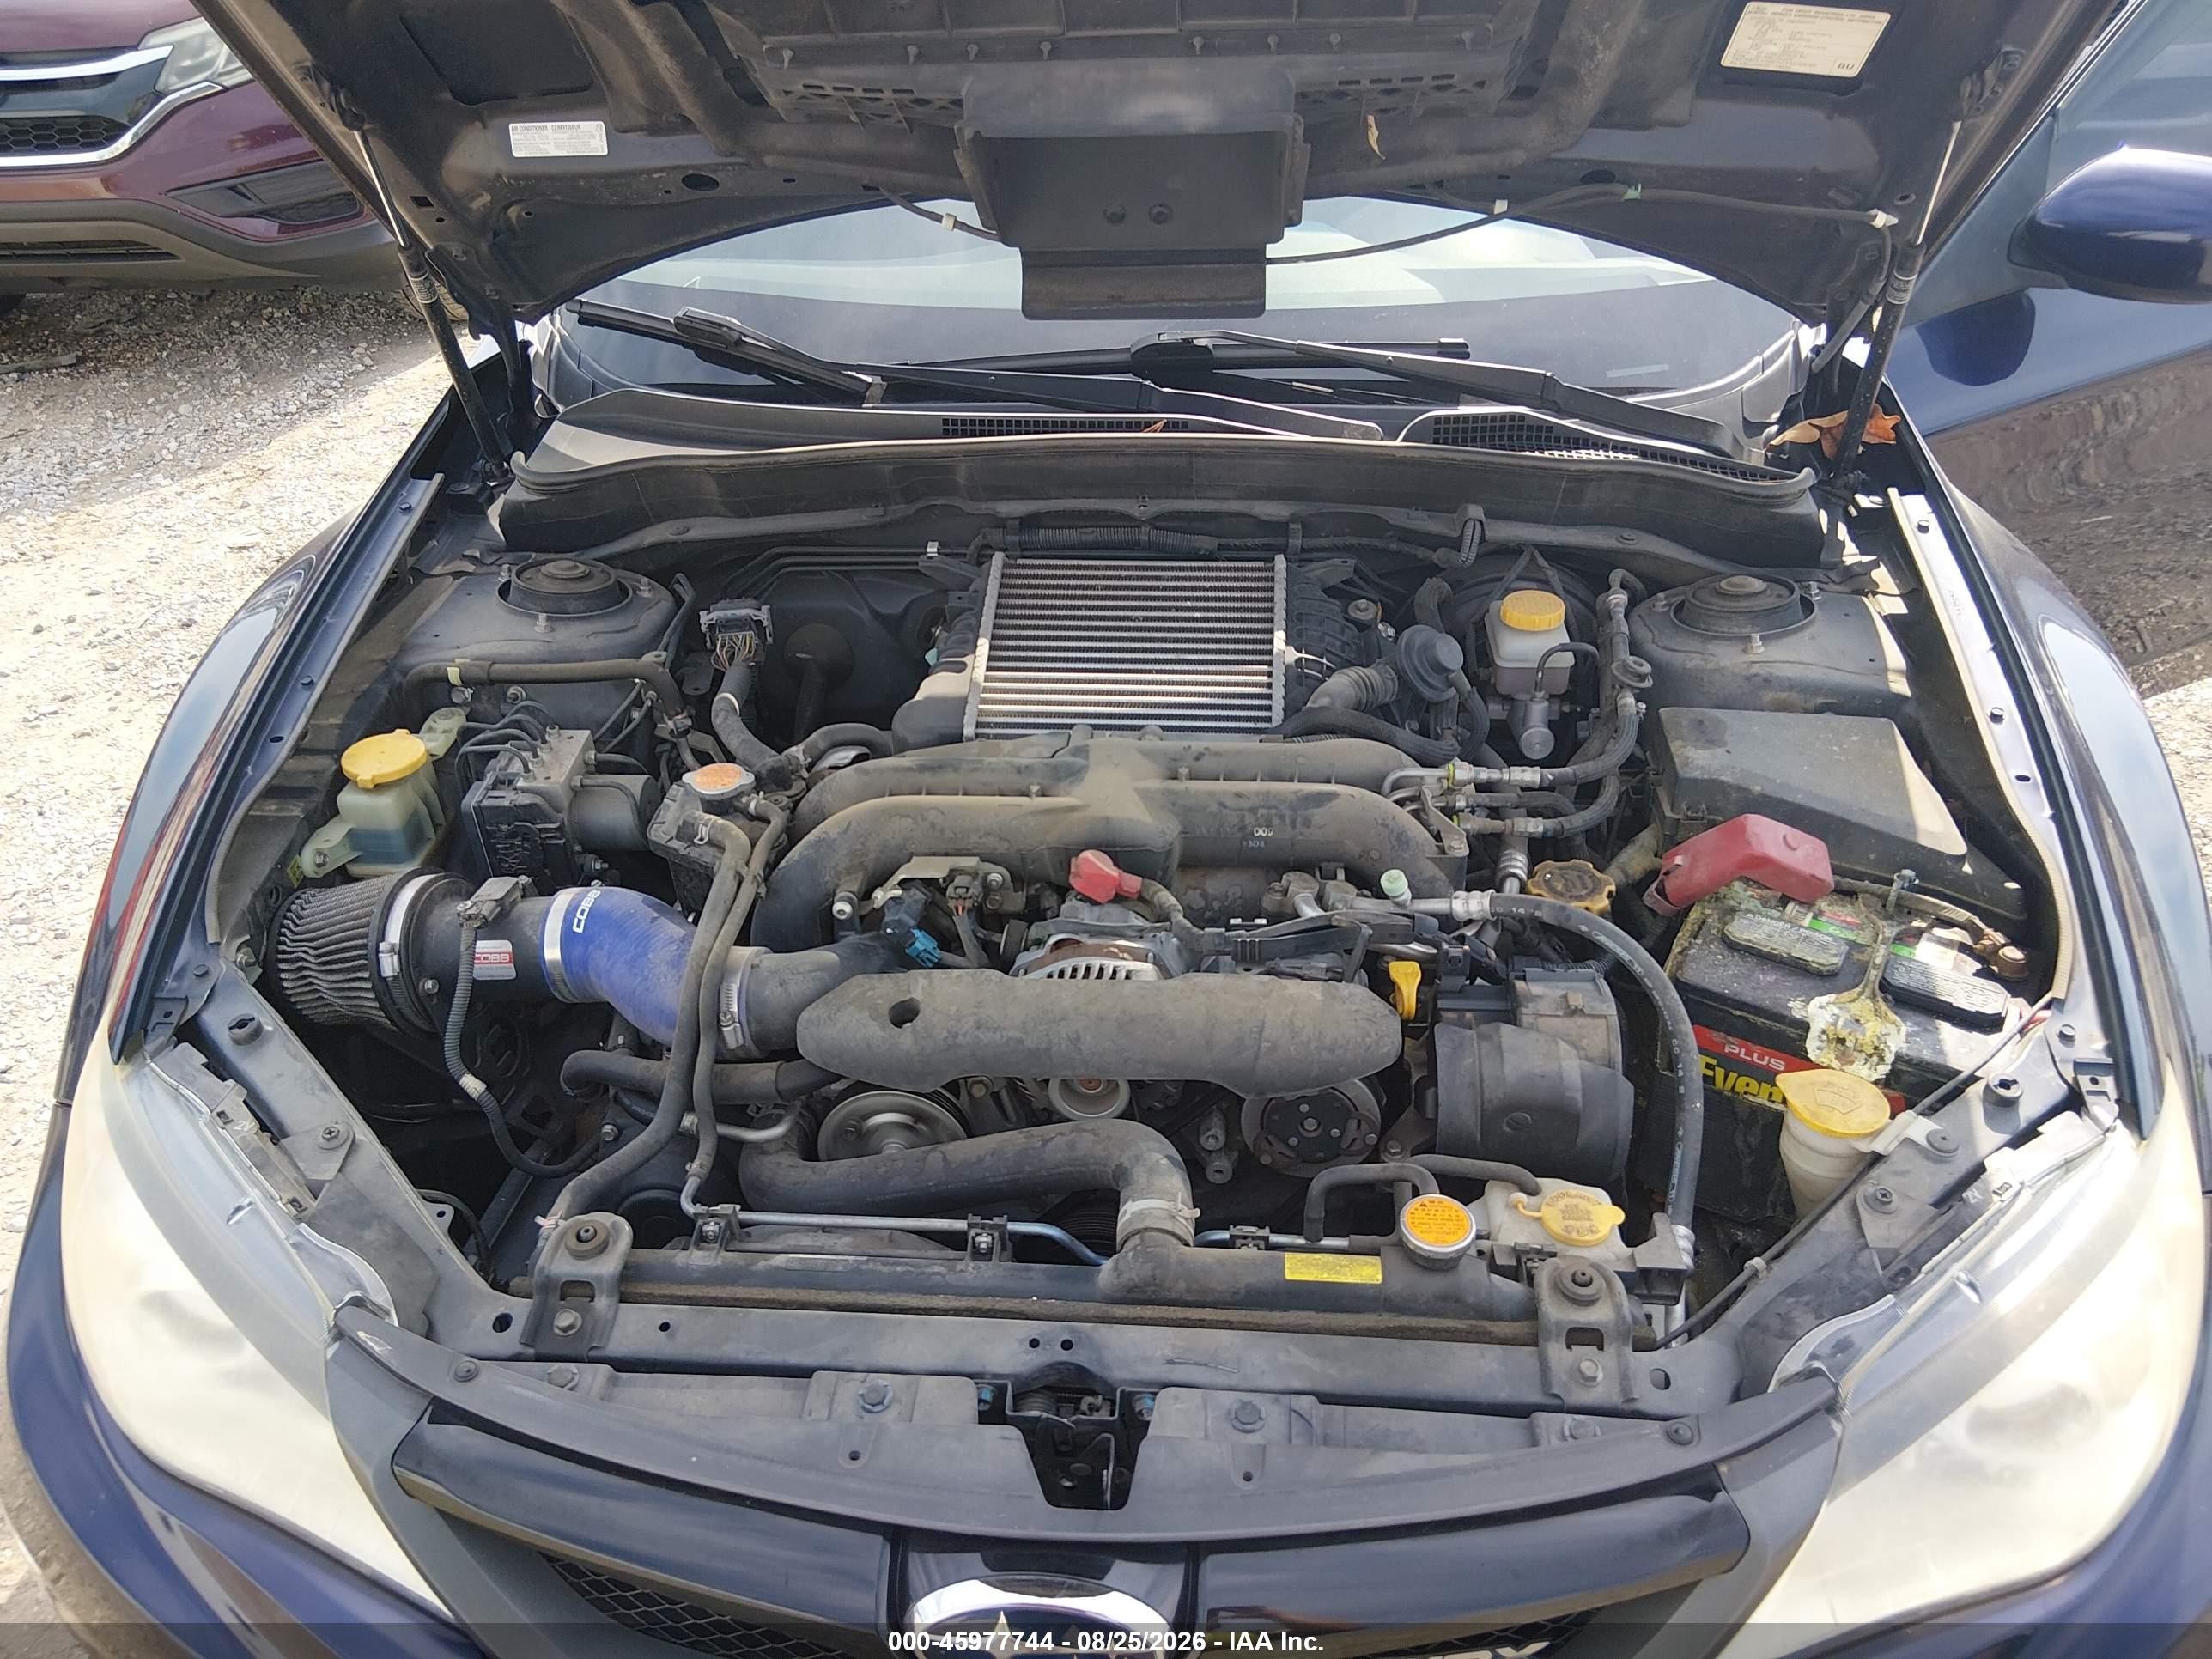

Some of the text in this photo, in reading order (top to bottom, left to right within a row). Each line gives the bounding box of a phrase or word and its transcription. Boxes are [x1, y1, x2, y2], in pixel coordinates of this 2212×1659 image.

[572, 889, 601, 933] COBB
[474, 953, 510, 963] COBB
[1723, 1043, 1786, 1072] PLUS
